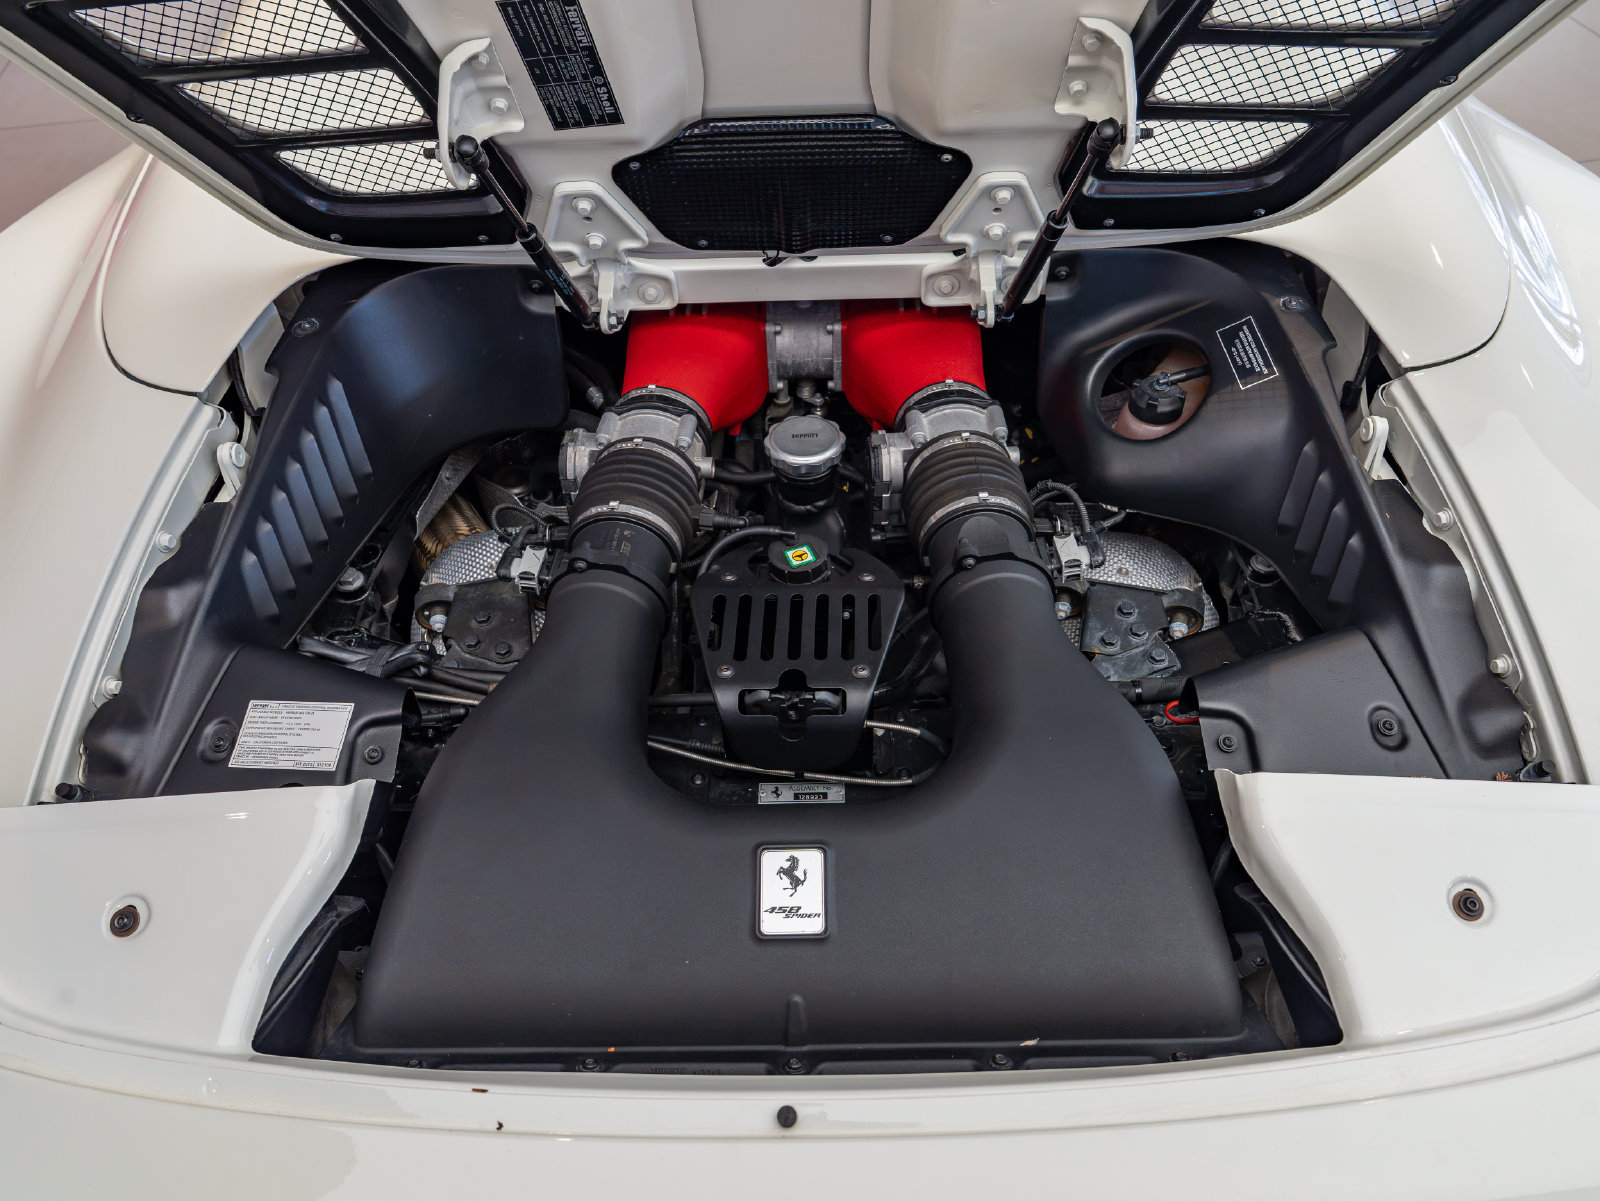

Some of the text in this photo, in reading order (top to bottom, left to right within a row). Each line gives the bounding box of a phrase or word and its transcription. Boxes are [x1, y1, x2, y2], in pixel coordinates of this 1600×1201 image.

[563, 5, 591, 46] Ferrari
[596, 86, 615, 113] Shell
[763, 906, 802, 914] 458
